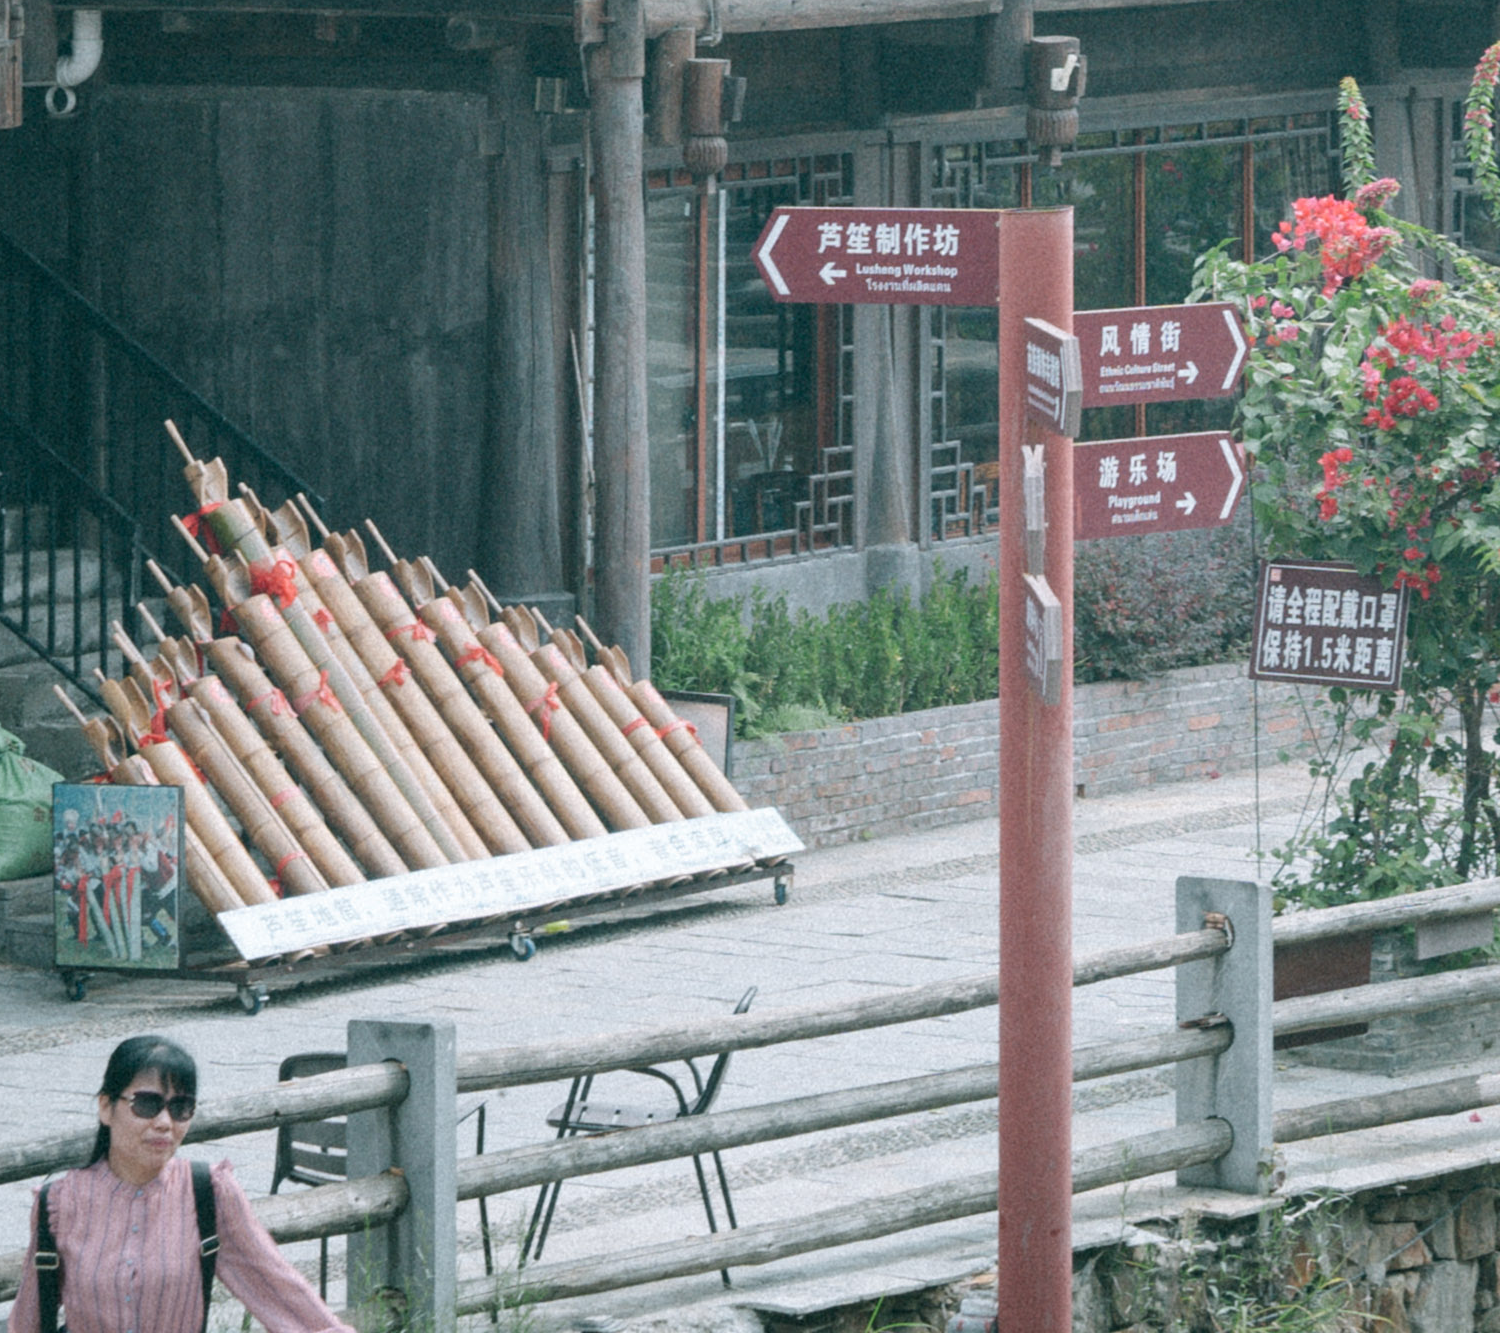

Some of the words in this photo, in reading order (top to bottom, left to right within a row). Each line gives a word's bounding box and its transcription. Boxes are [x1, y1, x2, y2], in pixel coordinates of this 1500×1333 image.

[817, 222, 960, 256] 芦笙制作坊
[856, 262, 901, 278] Lusheng
[903, 264, 958, 279] Workshop
[1100, 321, 1181, 357] 风情街
[1099, 451, 1177, 488] 游乐场
[1108, 491, 1161, 509] Playground
[1267, 584, 1397, 632] 请全程配戴口罩
[1263, 628, 1393, 678] 保持1.5米距离
